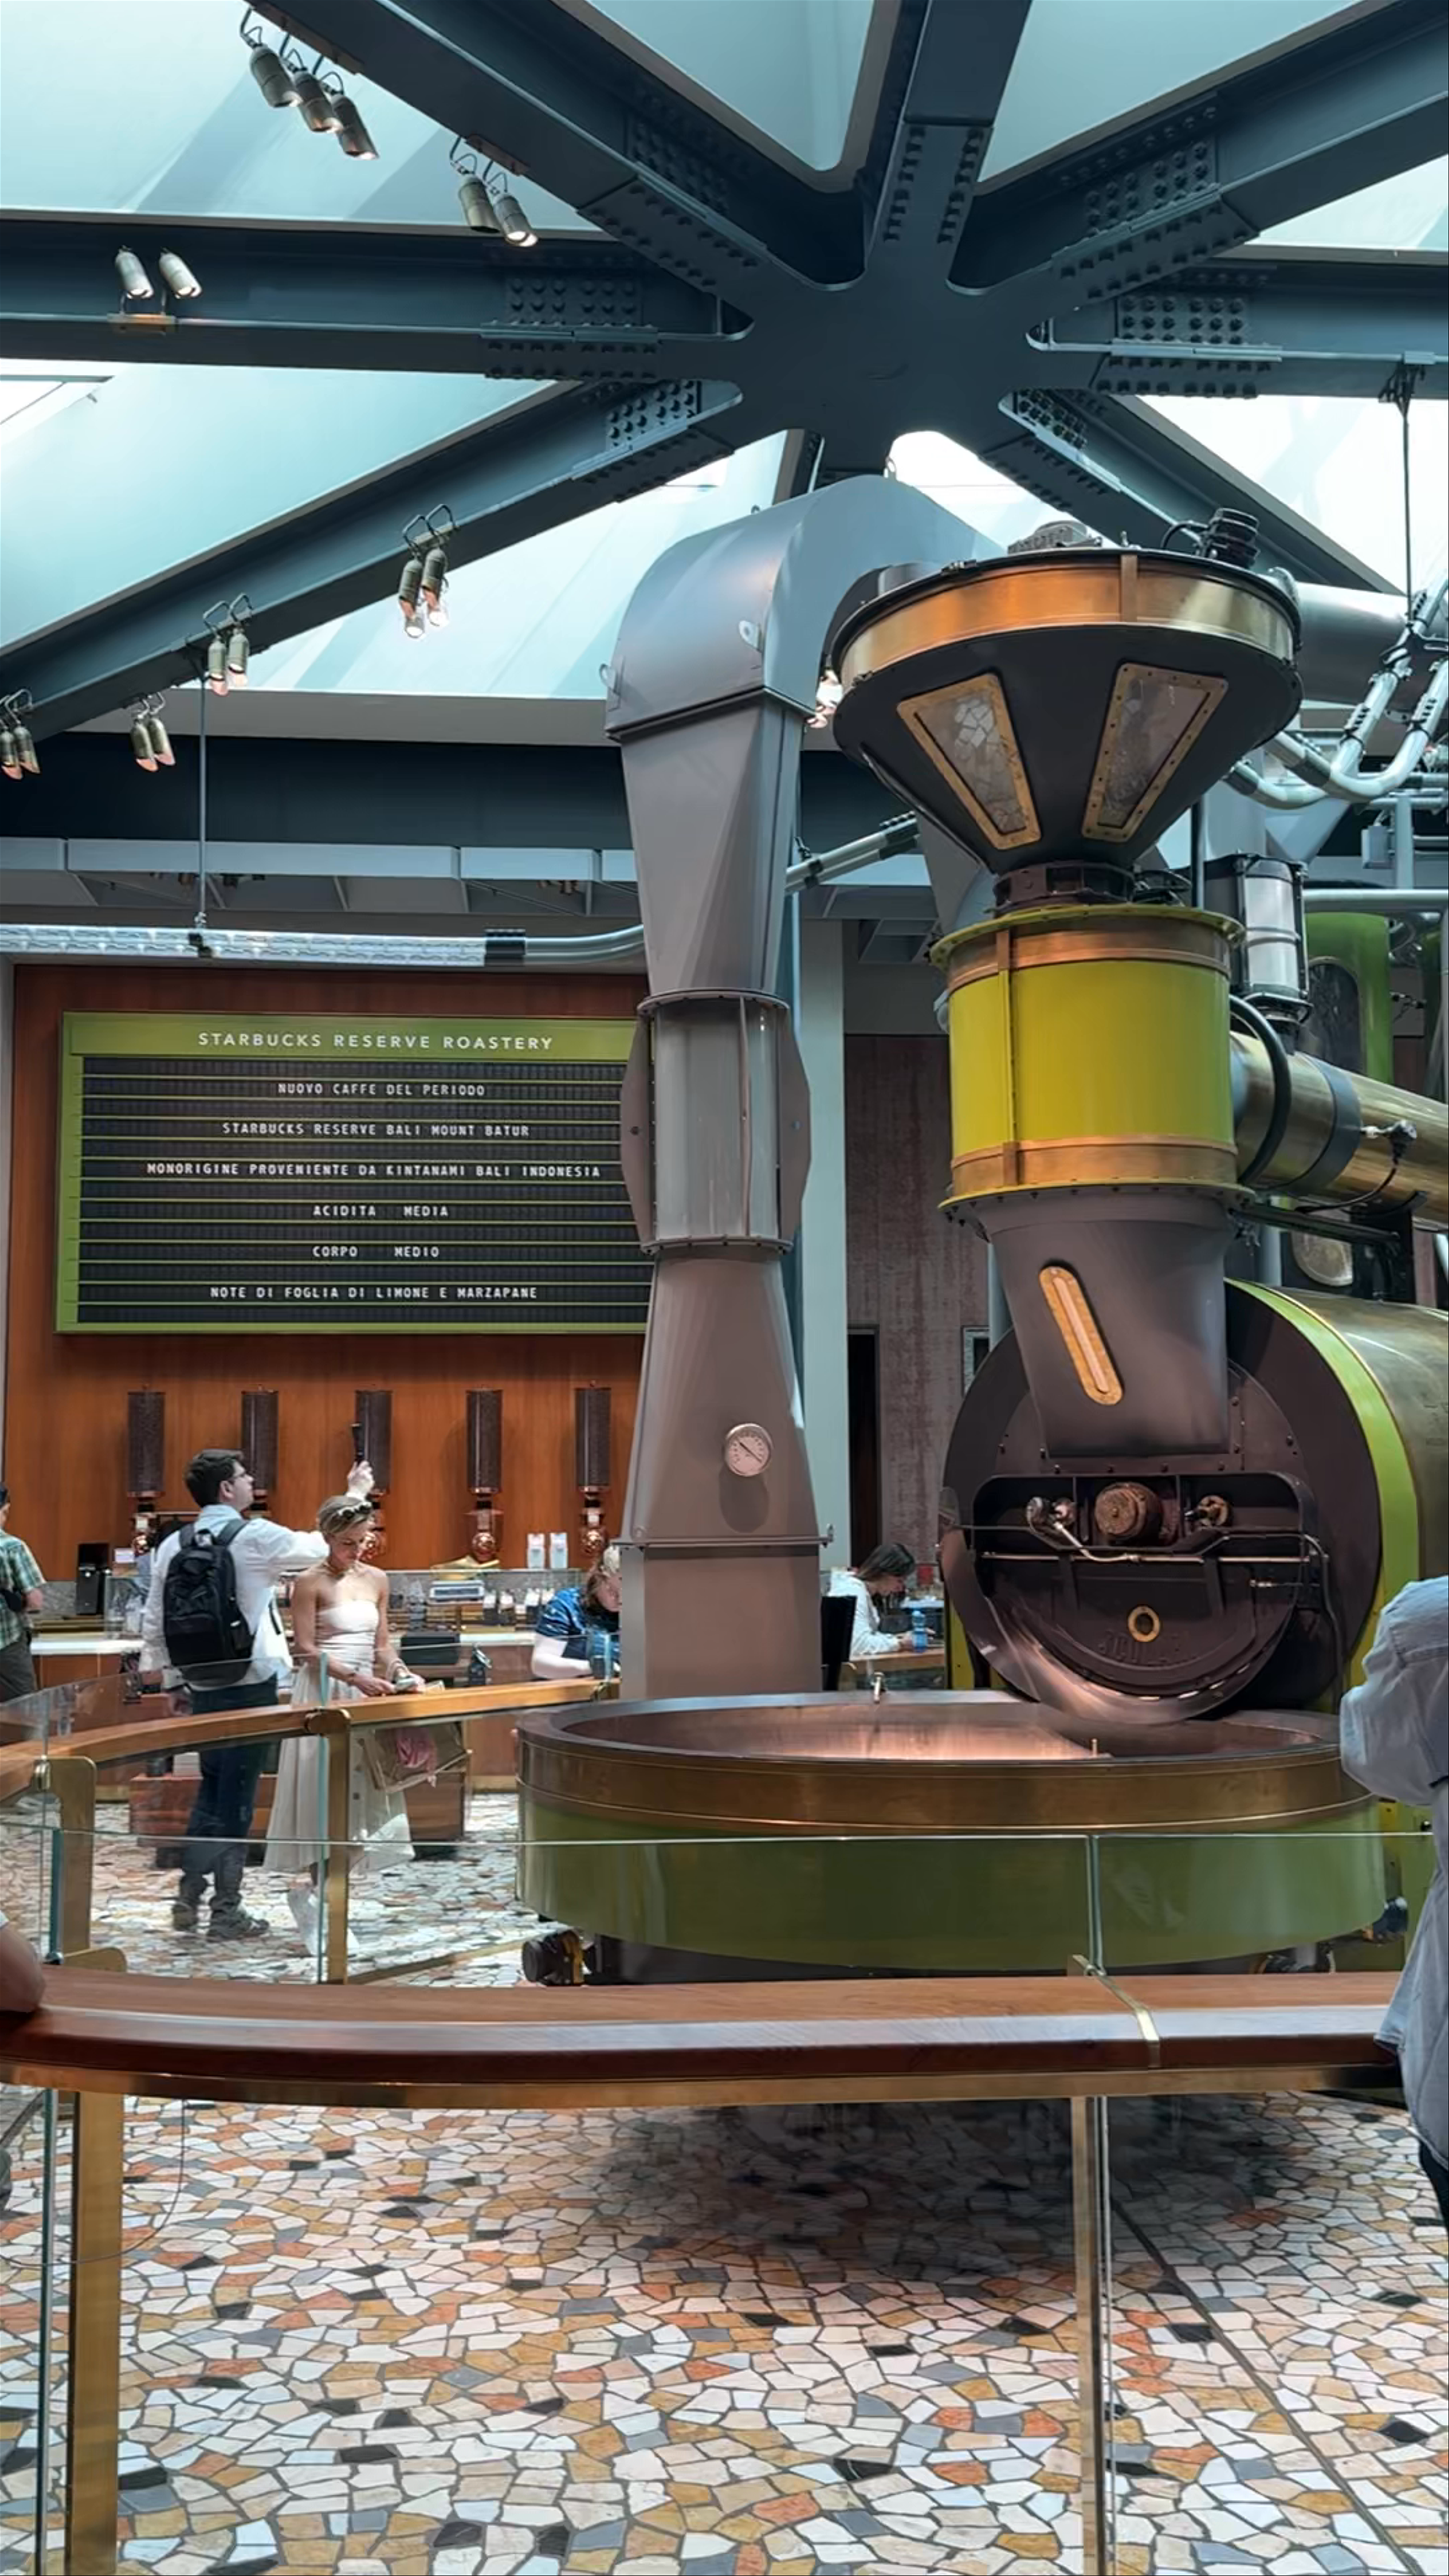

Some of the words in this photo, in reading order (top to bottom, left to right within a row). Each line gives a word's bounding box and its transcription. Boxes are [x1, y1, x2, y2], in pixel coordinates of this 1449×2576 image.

[199, 1032, 321, 1047] STARBUCKS
[334, 1034, 429, 1049] RESERVE
[443, 1036, 552, 1050] ROASTERY
[278, 1083, 323, 1094] NUOVO
[332, 1084, 376, 1095] CAFFE
[386, 1084, 412, 1095] DEL
[423, 1084, 485, 1096] PERIODO
[222, 1122, 305, 1134] STARBUCKS
[314, 1123, 376, 1135] RESERVE
[386, 1124, 420, 1135] BALI
[431, 1125, 474, 1136] MOUNT
[485, 1125, 529, 1136] BATUR
[147, 1163, 238, 1175] MONORIGINE
[249, 1163, 348, 1175] PROVENIENTE
[358, 1164, 376, 1176] DA
[475, 1165, 510, 1177] BALI
[522, 1166, 600, 1177] INDONESIA
[313, 1205, 376, 1216] ACIDITA
[403, 1205, 448, 1217] MEDIA
[312, 1246, 358, 1257] CORPO
[394, 1246, 439, 1257] MEDIO
[210, 1287, 246, 1298] NOTE
[256, 1287, 273, 1298] DI
[285, 1287, 338, 1298] FOGLIA
[348, 1287, 364, 1298] DI
[376, 1287, 429, 1298] LIMONE
[439, 1287, 447, 1298] E
[457, 1287, 537, 1298] MARZAPANE
